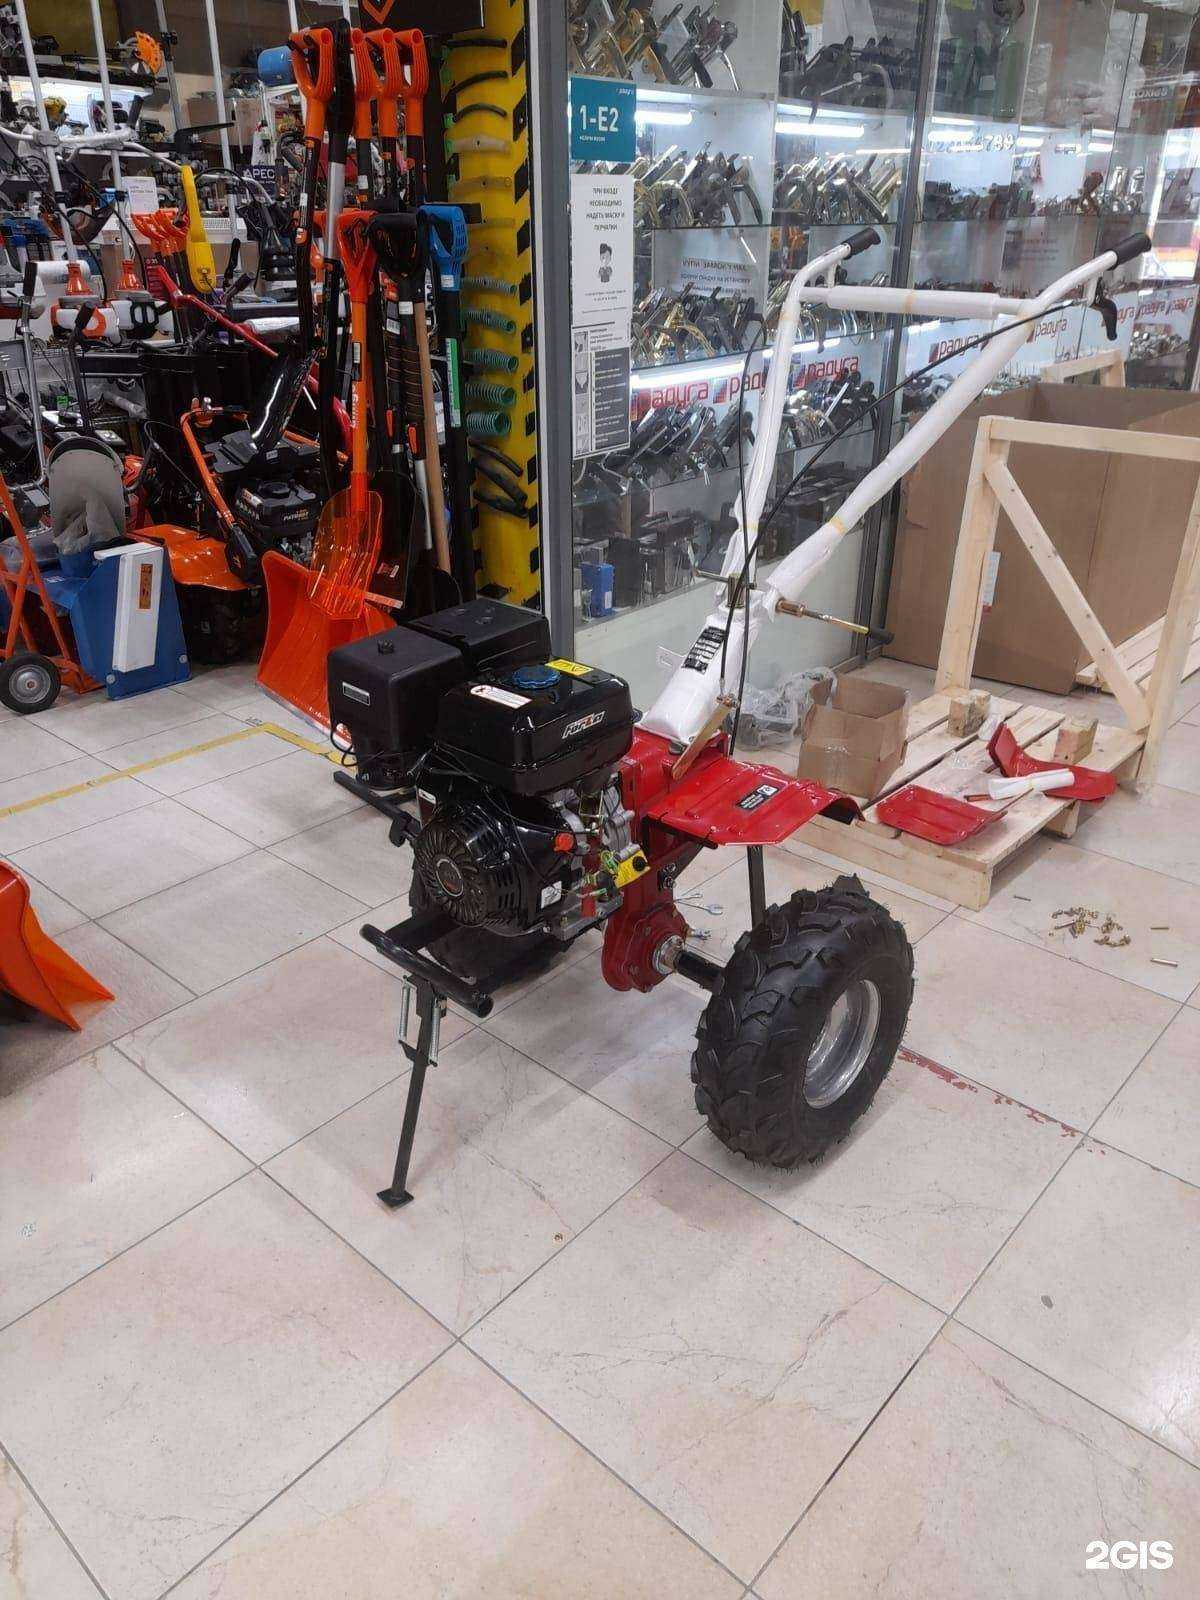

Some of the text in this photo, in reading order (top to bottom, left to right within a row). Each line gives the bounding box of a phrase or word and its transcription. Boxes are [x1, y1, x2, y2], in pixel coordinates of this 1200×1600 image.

[580, 104, 619, 132] 1-E2
[589, 199, 623, 207] НЕОБХОДИМО
[1035, 319, 1068, 342] радуга
[807, 356, 859, 383] радуга
